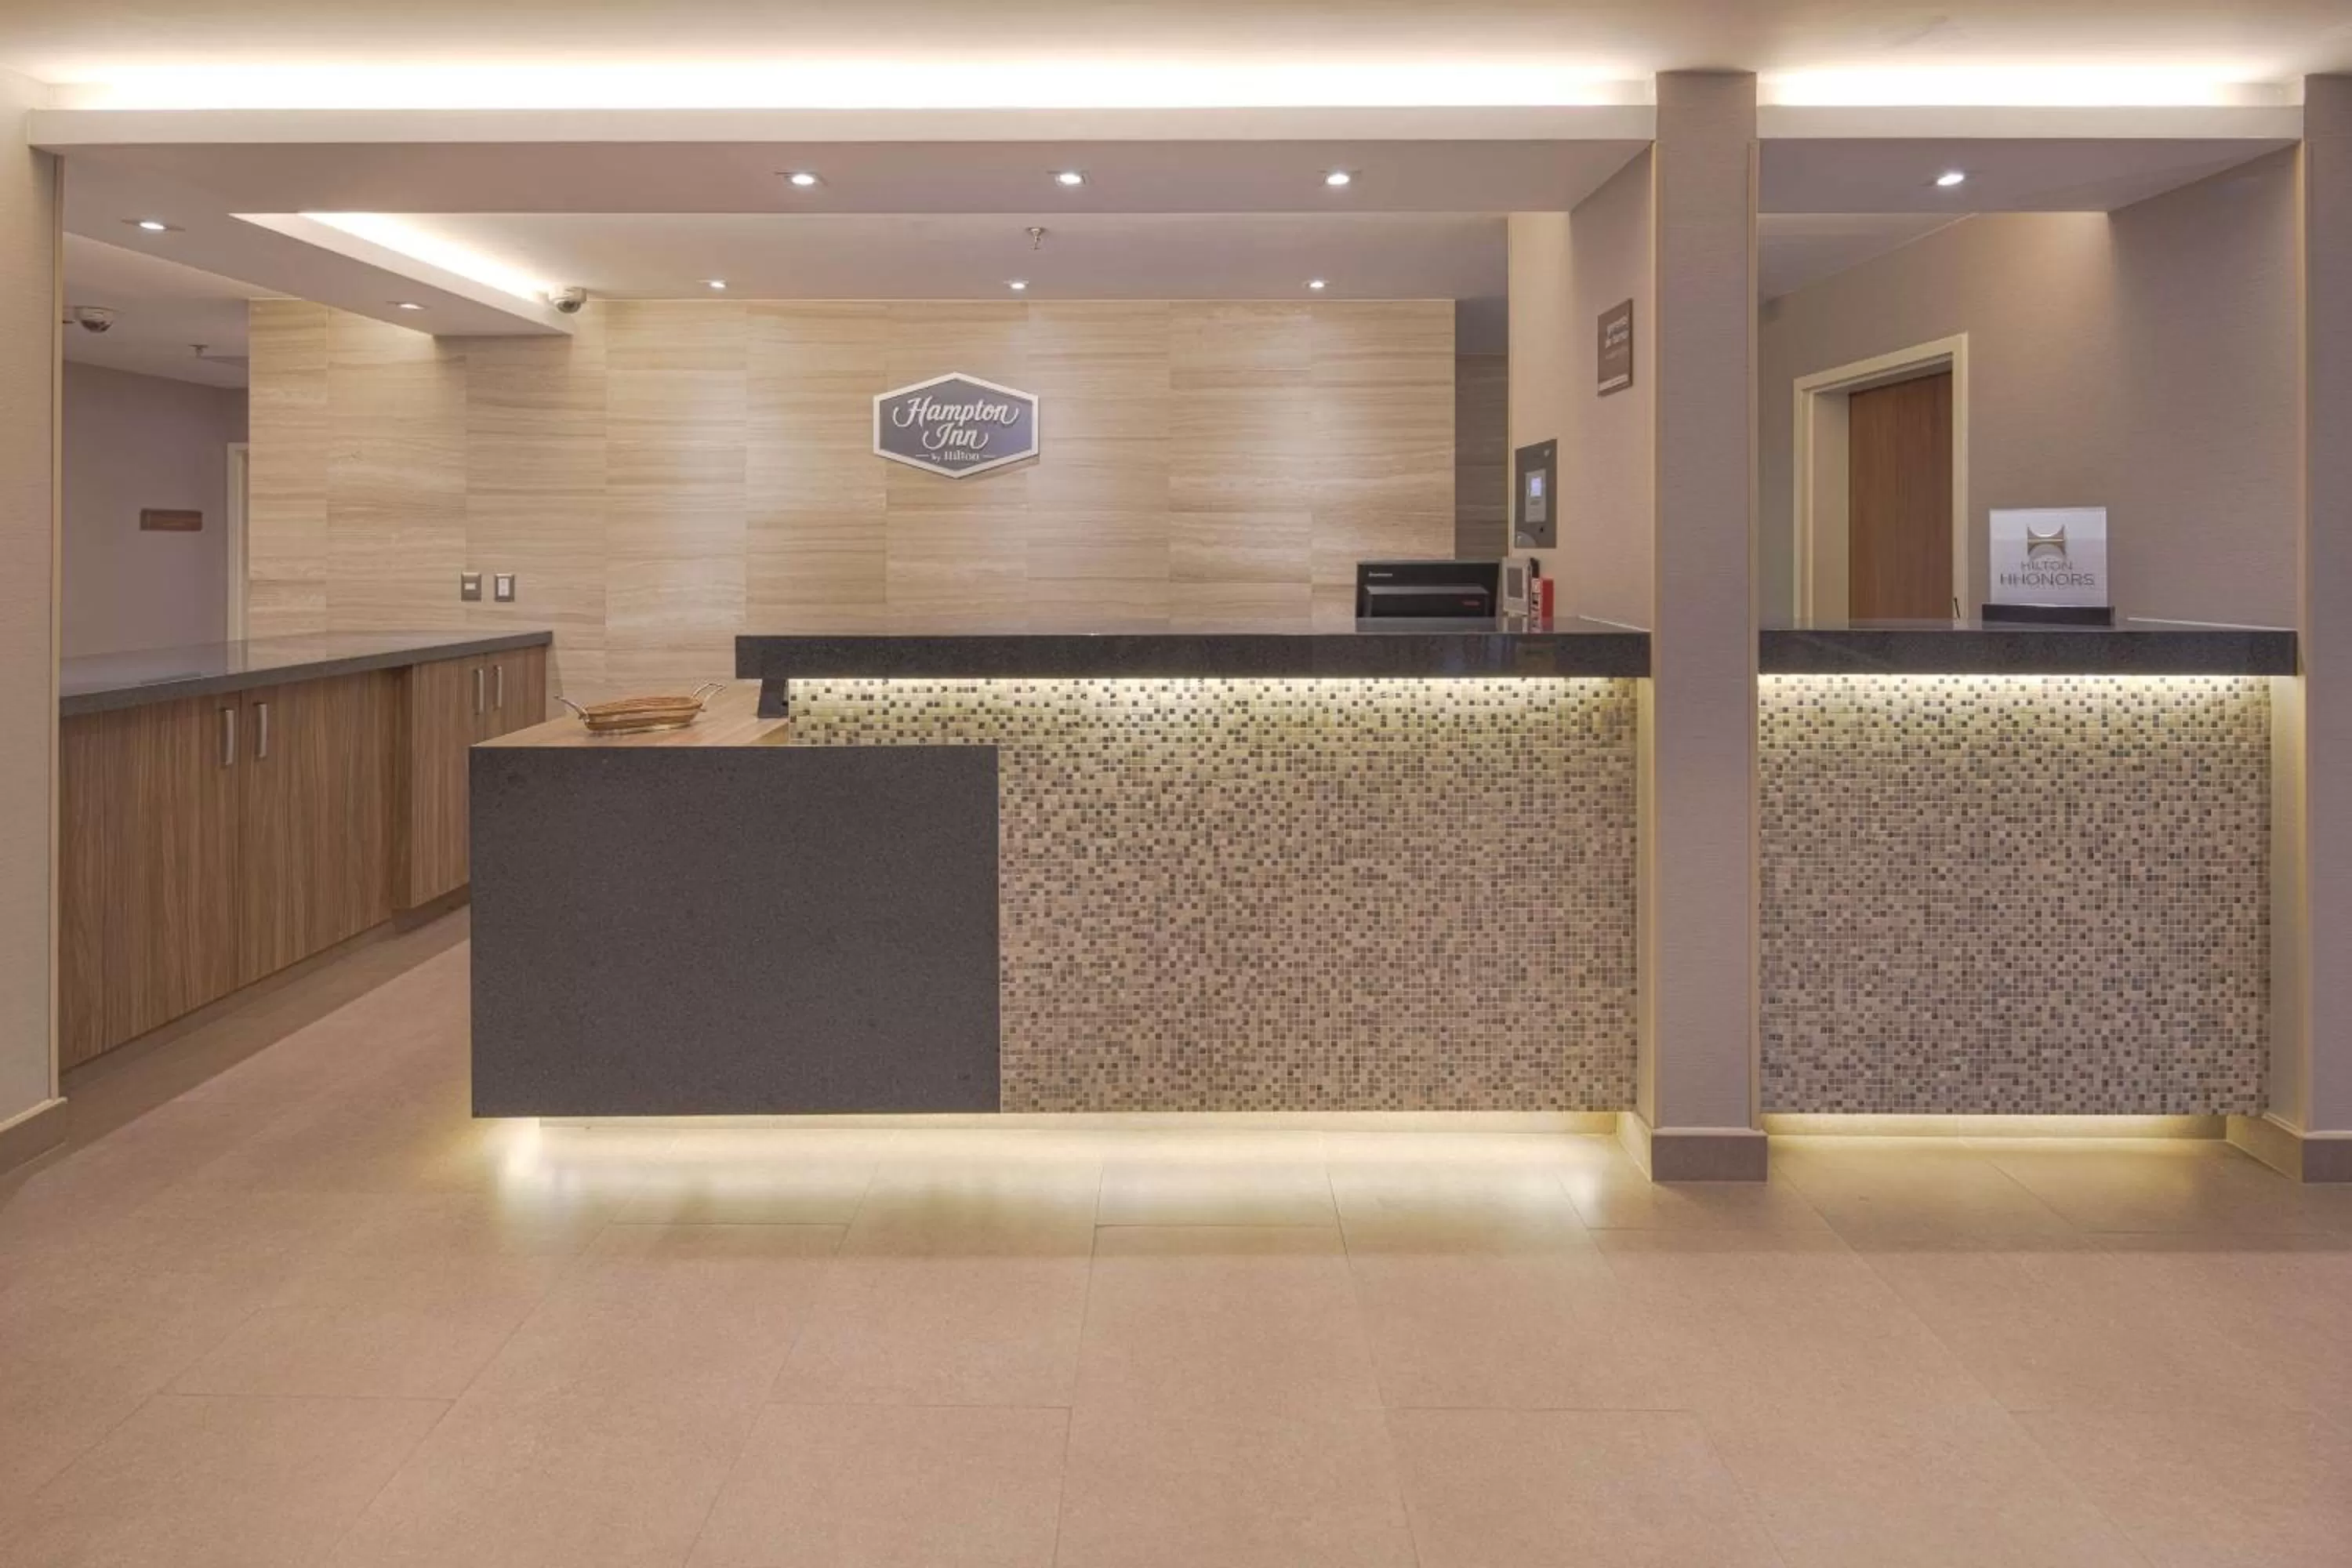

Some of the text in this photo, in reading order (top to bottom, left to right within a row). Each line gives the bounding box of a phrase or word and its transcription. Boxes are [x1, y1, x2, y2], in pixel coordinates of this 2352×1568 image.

[892, 395, 1018, 427] Hampton
[922, 423, 989, 450] Inn
[944, 449, 979, 461] Hilton
[2020, 560, 2073, 571] HILTON
[2000, 573, 2095, 586] HHONORS
